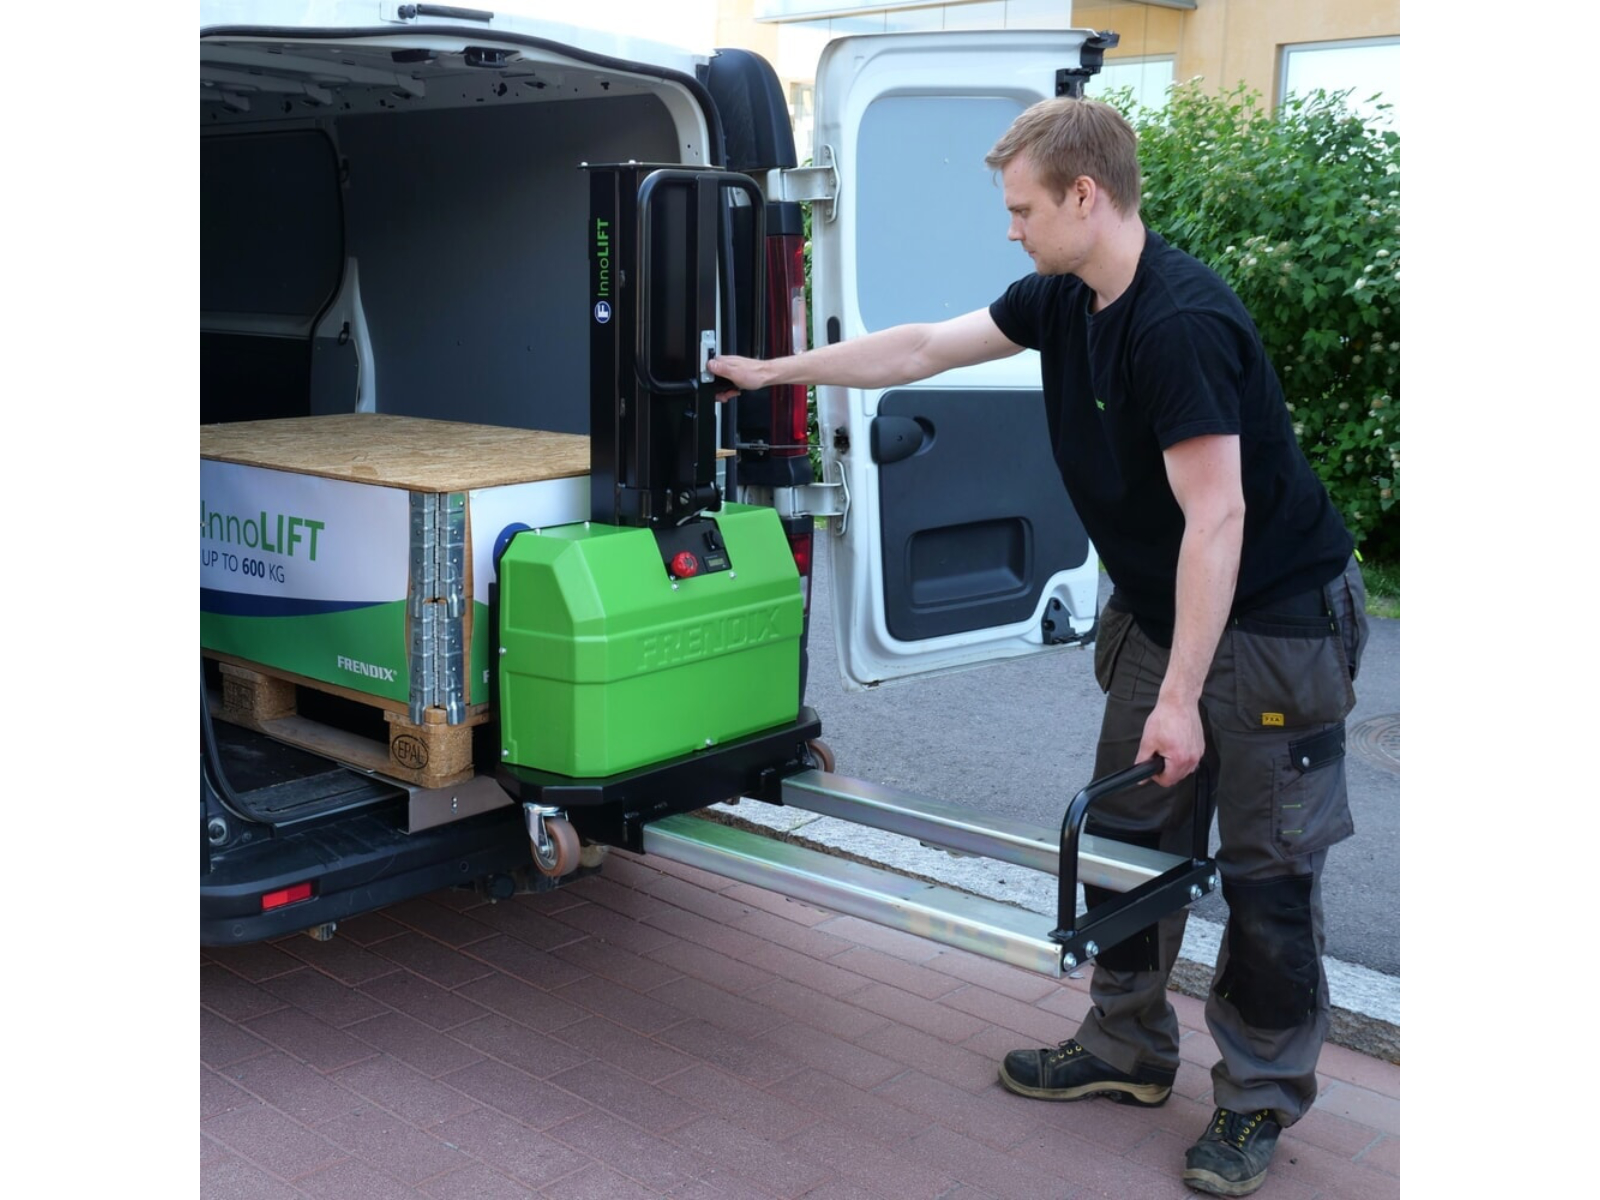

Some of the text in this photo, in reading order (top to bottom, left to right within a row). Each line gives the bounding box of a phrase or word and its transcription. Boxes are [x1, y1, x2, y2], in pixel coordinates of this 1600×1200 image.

[597, 218, 609, 296] InnoLIFT
[201, 500, 325, 561] InnoLIFT
[202, 549, 285, 583] UP TO 600 KG
[638, 607, 780, 670] FRENDIX
[397, 740, 425, 765] EPAL
